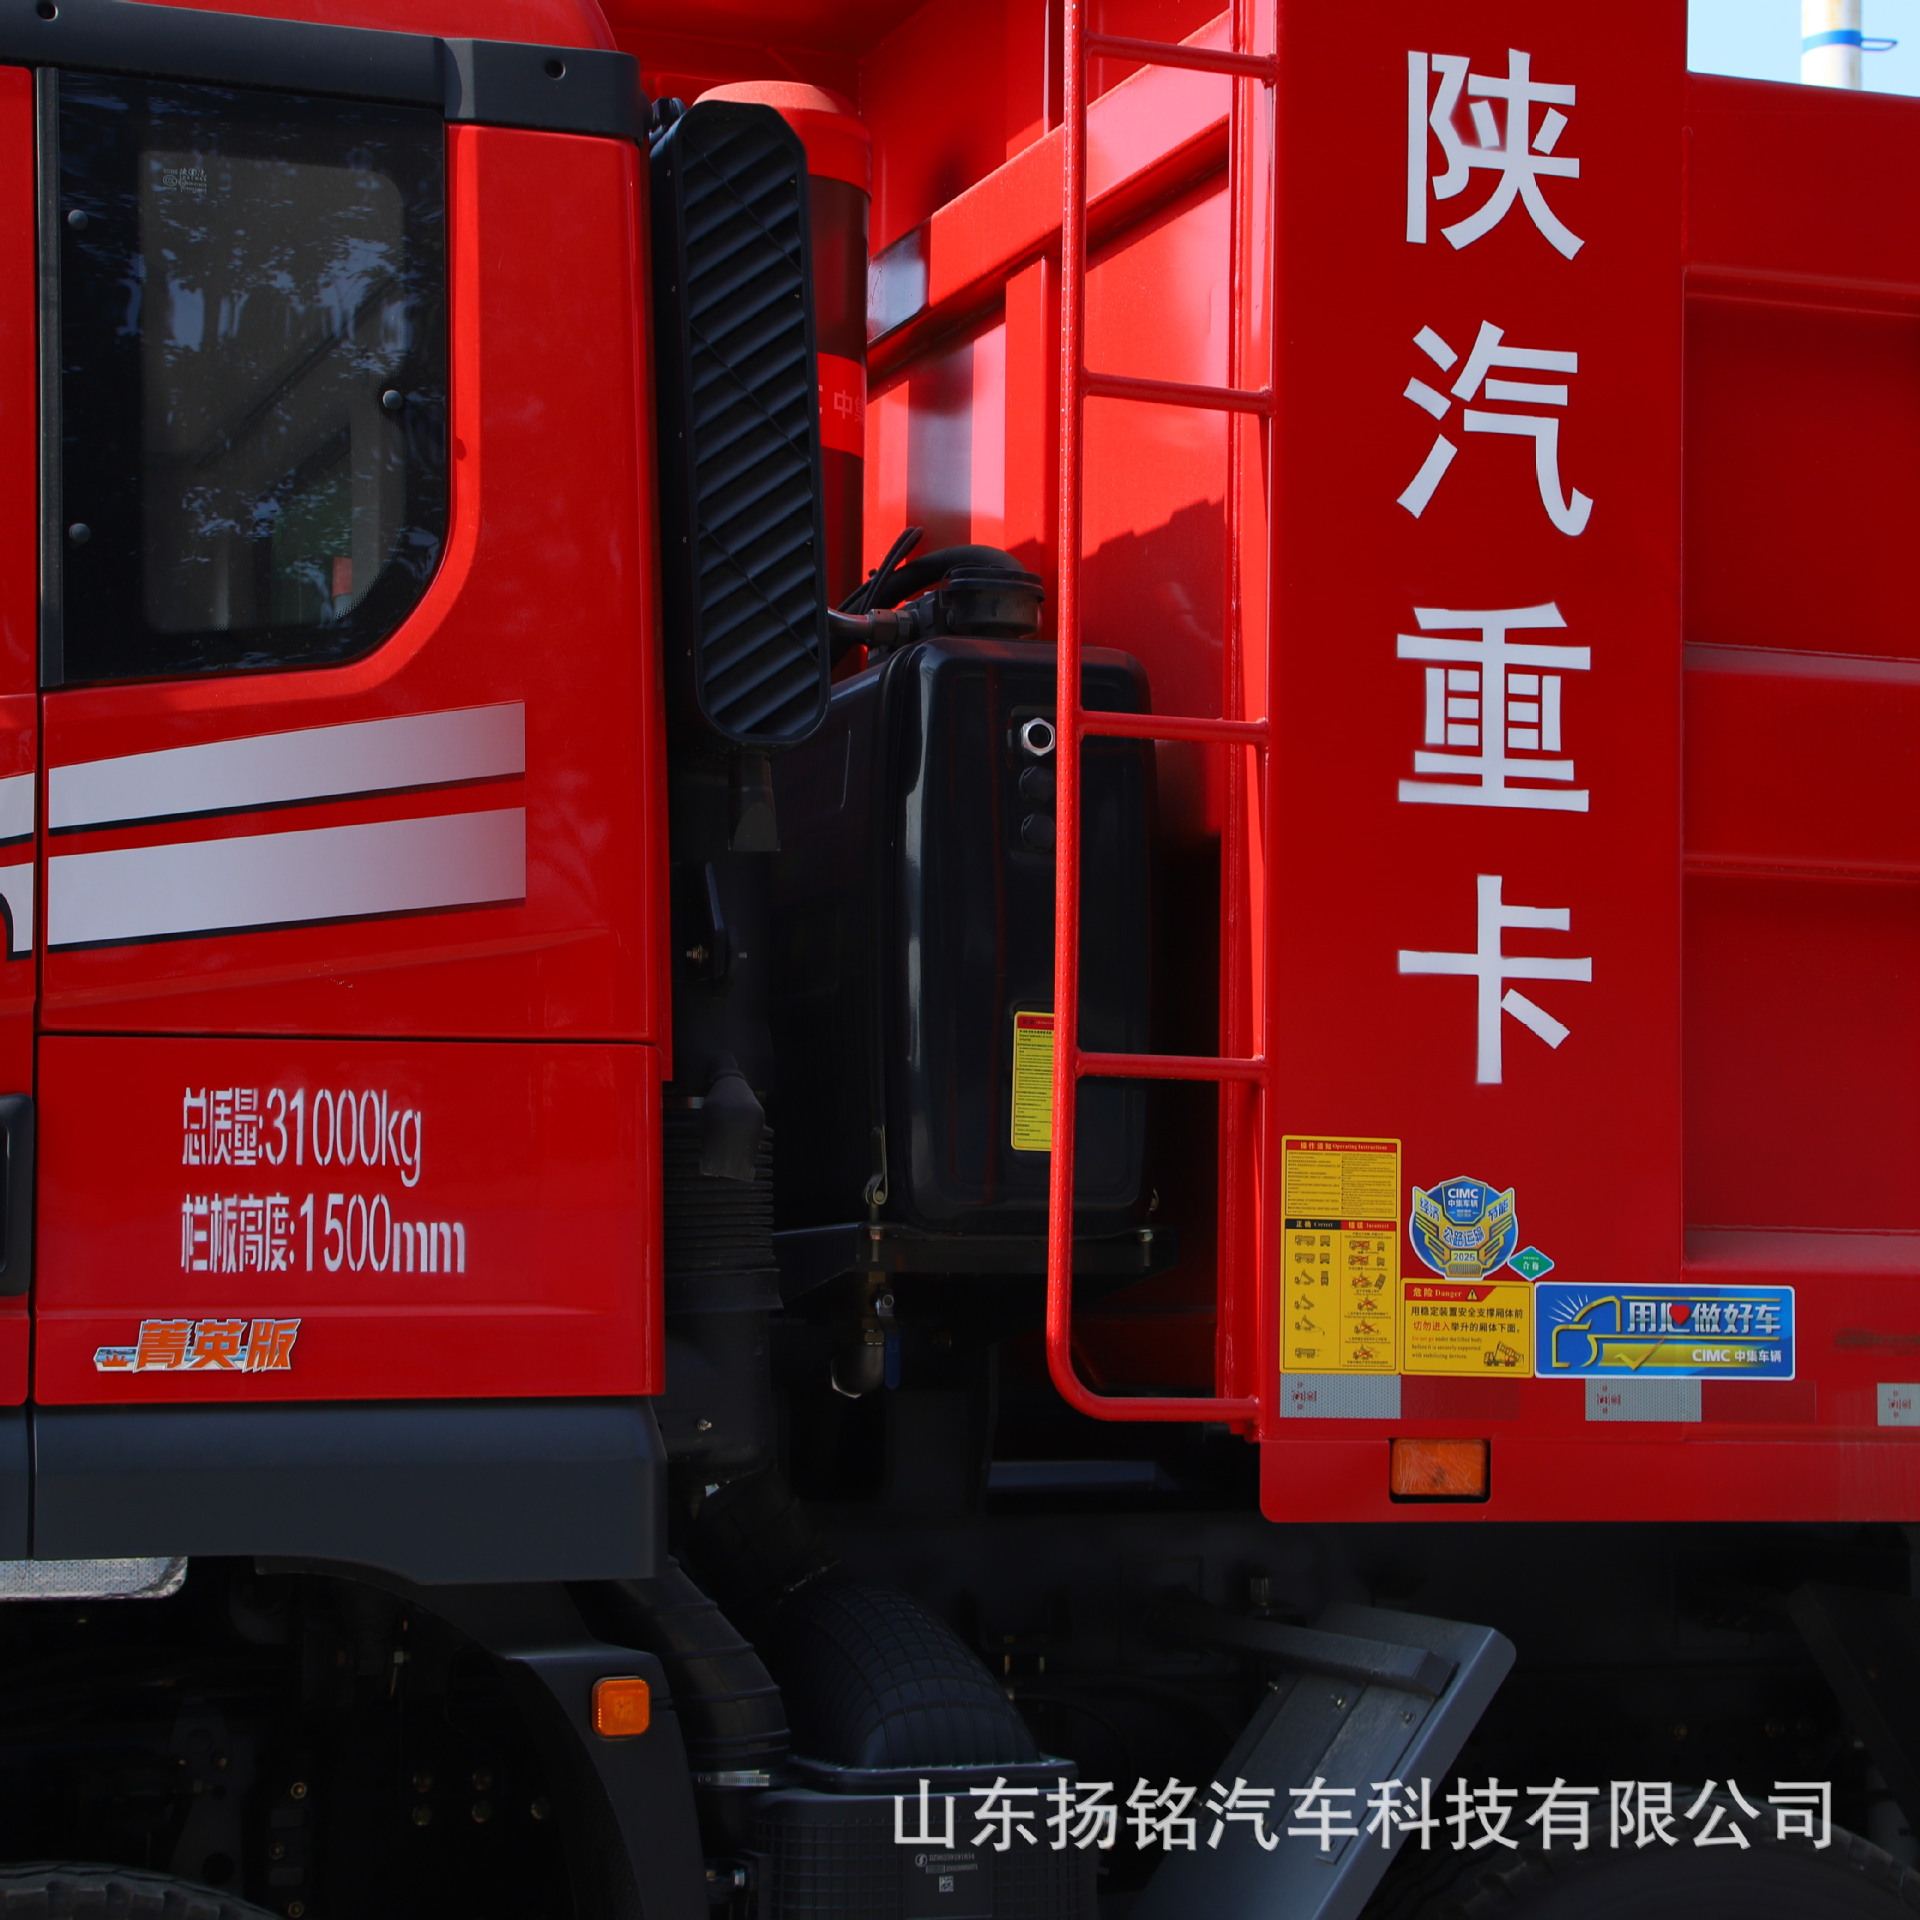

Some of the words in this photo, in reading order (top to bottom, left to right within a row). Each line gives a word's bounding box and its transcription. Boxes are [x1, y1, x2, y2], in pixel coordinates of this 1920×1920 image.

[1397, 48, 1593, 1084] 陕汽重卡
[1448, 1188, 1479, 1199] CIMC
[1448, 1199, 1478, 1208] 中集车辆
[1442, 1225, 1485, 1248] 公路运输
[1454, 1252, 1475, 1262] 2025
[1413, 1287, 1433, 1298] 危险
[1435, 1289, 1463, 1298] Danger
[1627, 1301, 1782, 1334] 用心做好车
[133, 1319, 301, 1372] 菁英版
[1692, 1349, 1731, 1362] CIMC
[1734, 1349, 1782, 1363] 中集车辆
